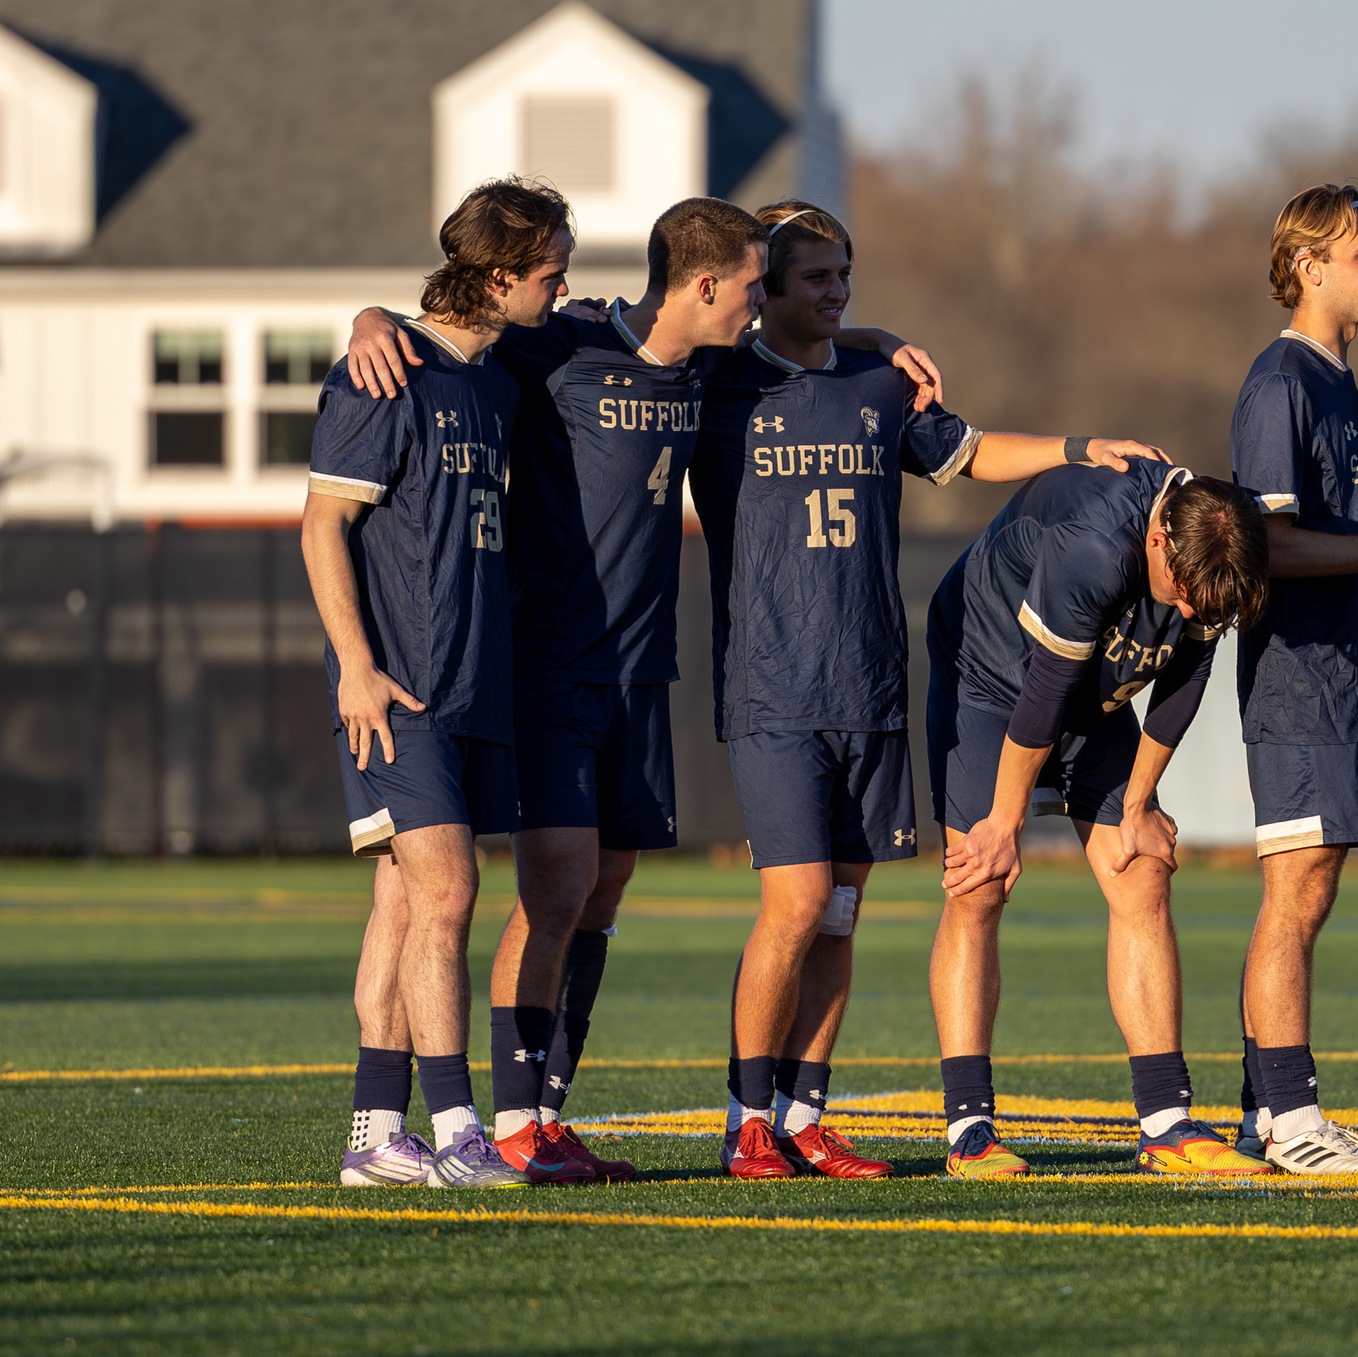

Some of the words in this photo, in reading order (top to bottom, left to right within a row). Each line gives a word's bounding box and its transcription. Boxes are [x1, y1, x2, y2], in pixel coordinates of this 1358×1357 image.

[598, 398, 702, 432] SUFFOLK
[647, 446, 673, 506] 4
[753, 444, 885, 477] SUFFOLK
[469, 488, 504, 553] 29
[804, 488, 856, 548] 15
[1101, 680, 1147, 713] 9
